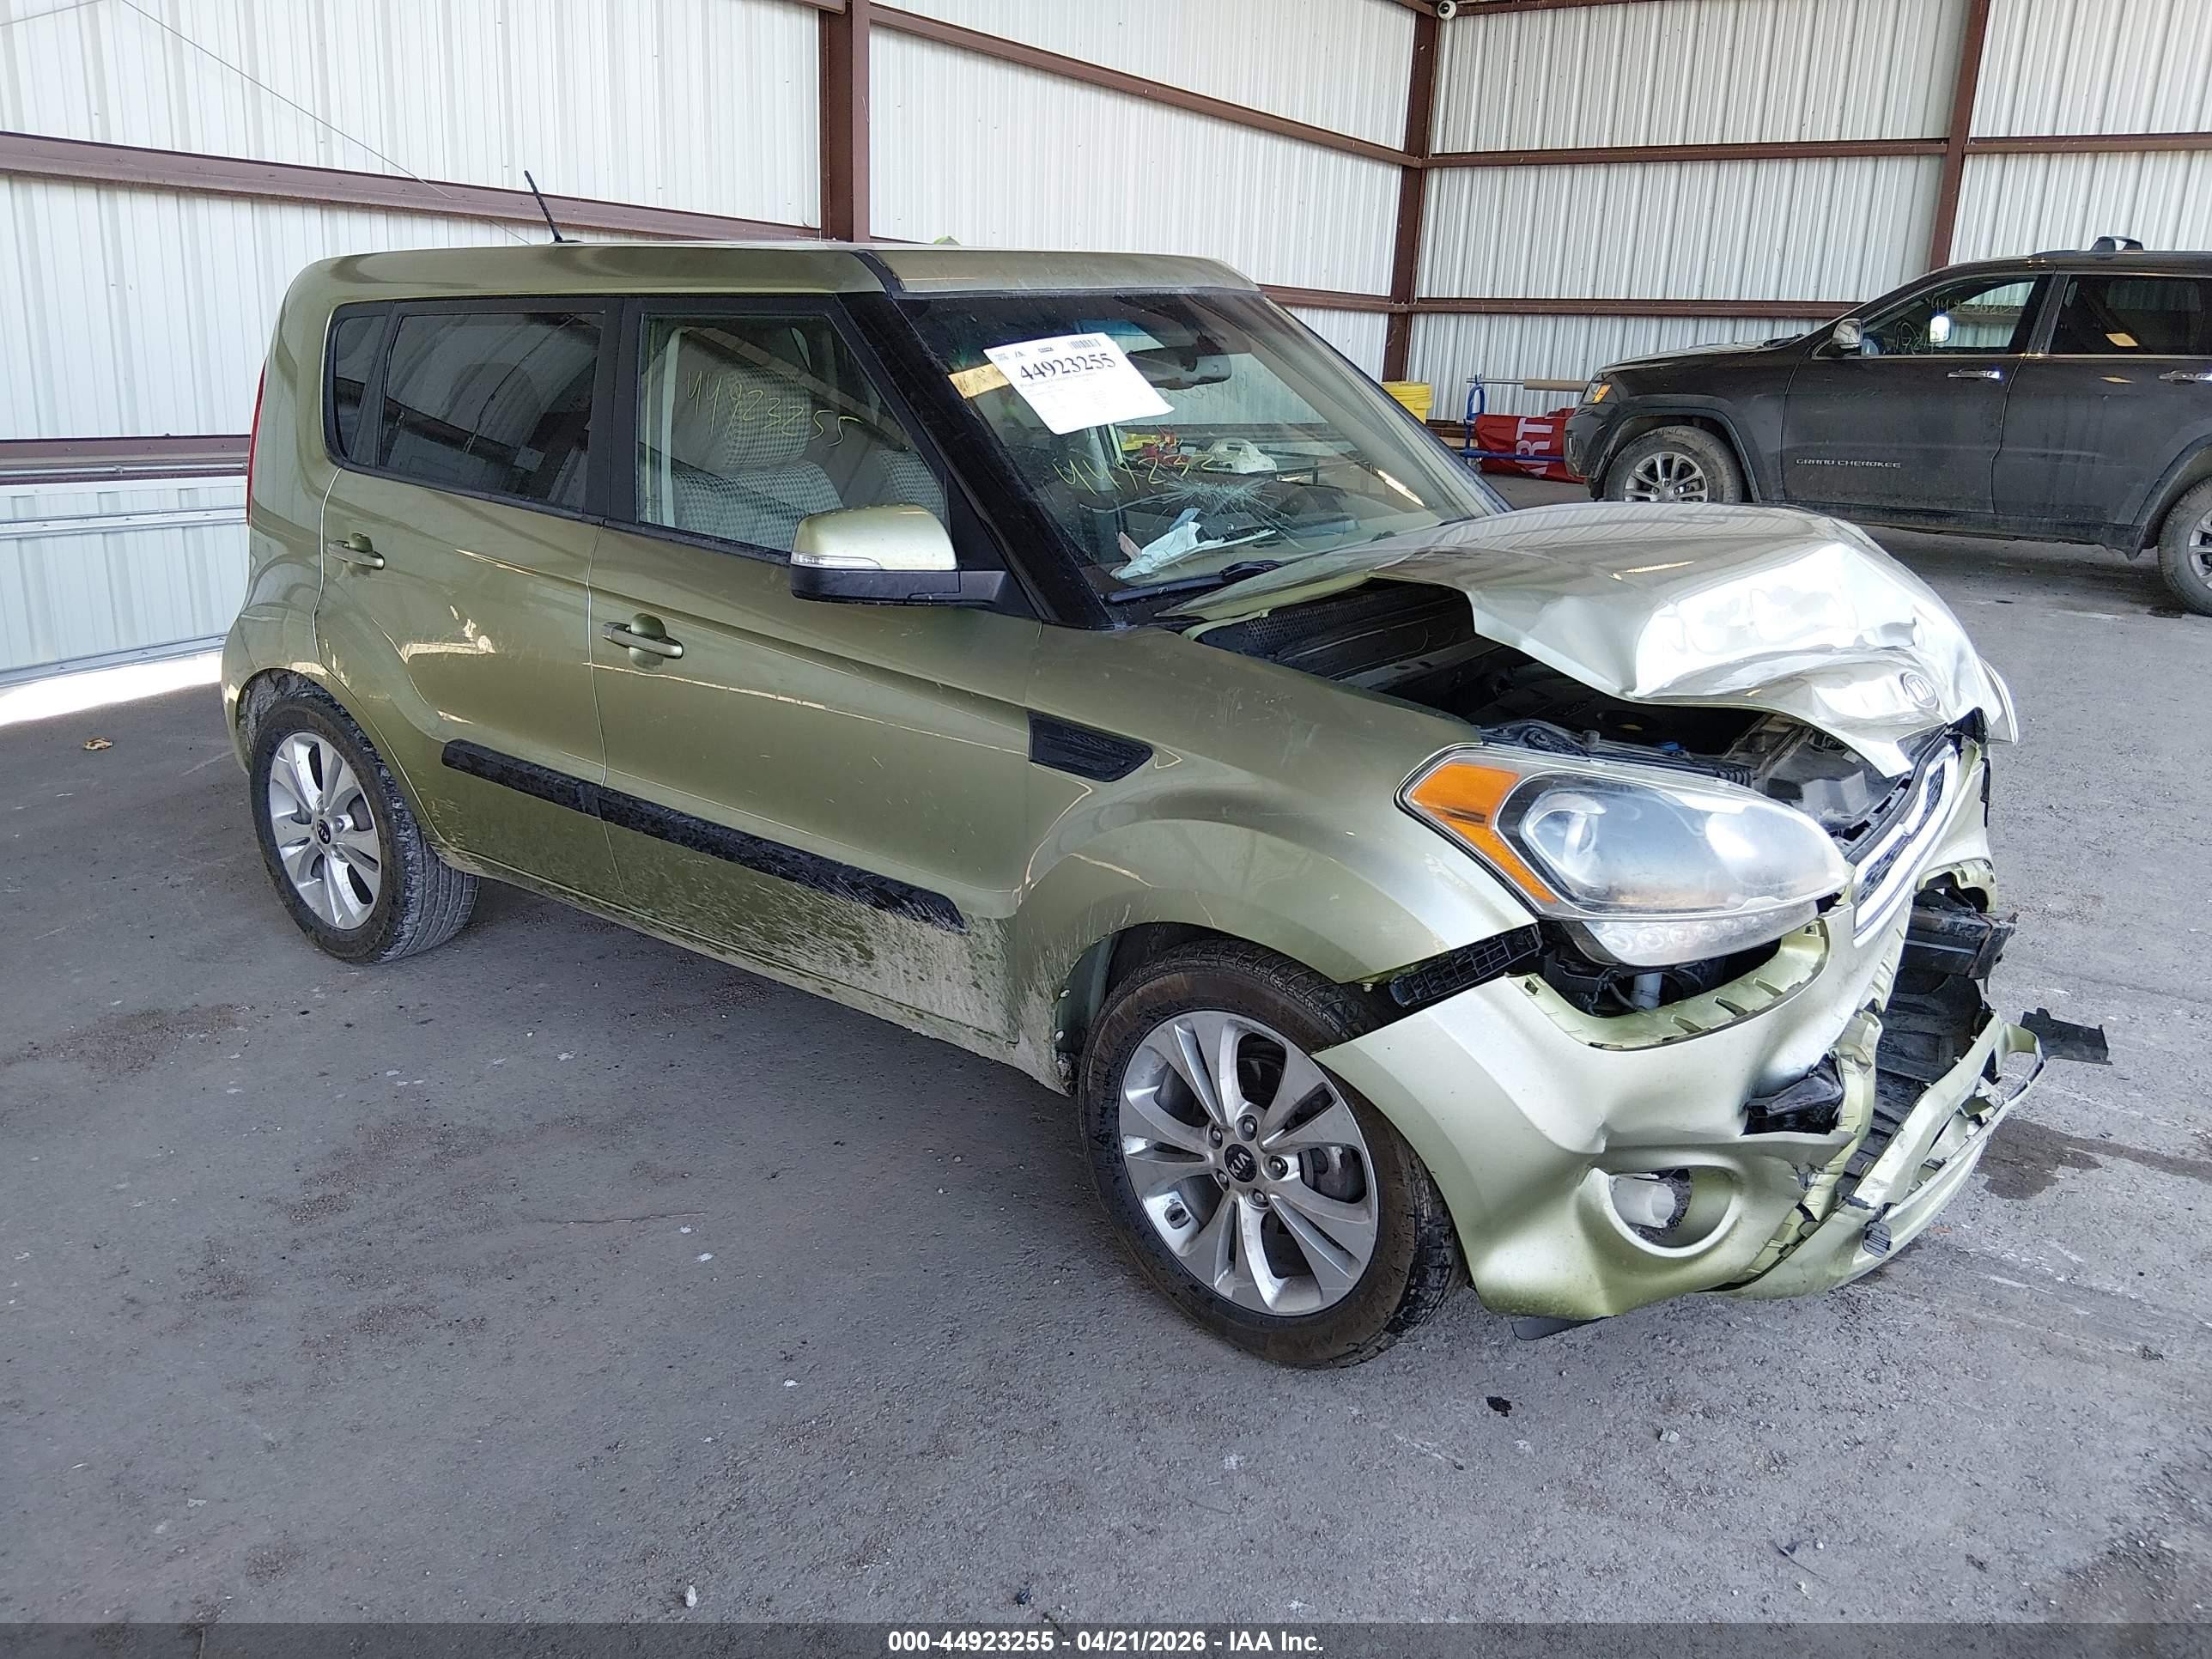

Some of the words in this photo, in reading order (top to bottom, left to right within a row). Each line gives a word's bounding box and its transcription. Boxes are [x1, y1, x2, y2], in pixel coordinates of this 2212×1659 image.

[1020, 353, 1116, 380] 44923255
[687, 370, 864, 447] 44923255
[1837, 459, 1901, 469] CHEROKEE
[1229, 1152, 1251, 1177] KIA
